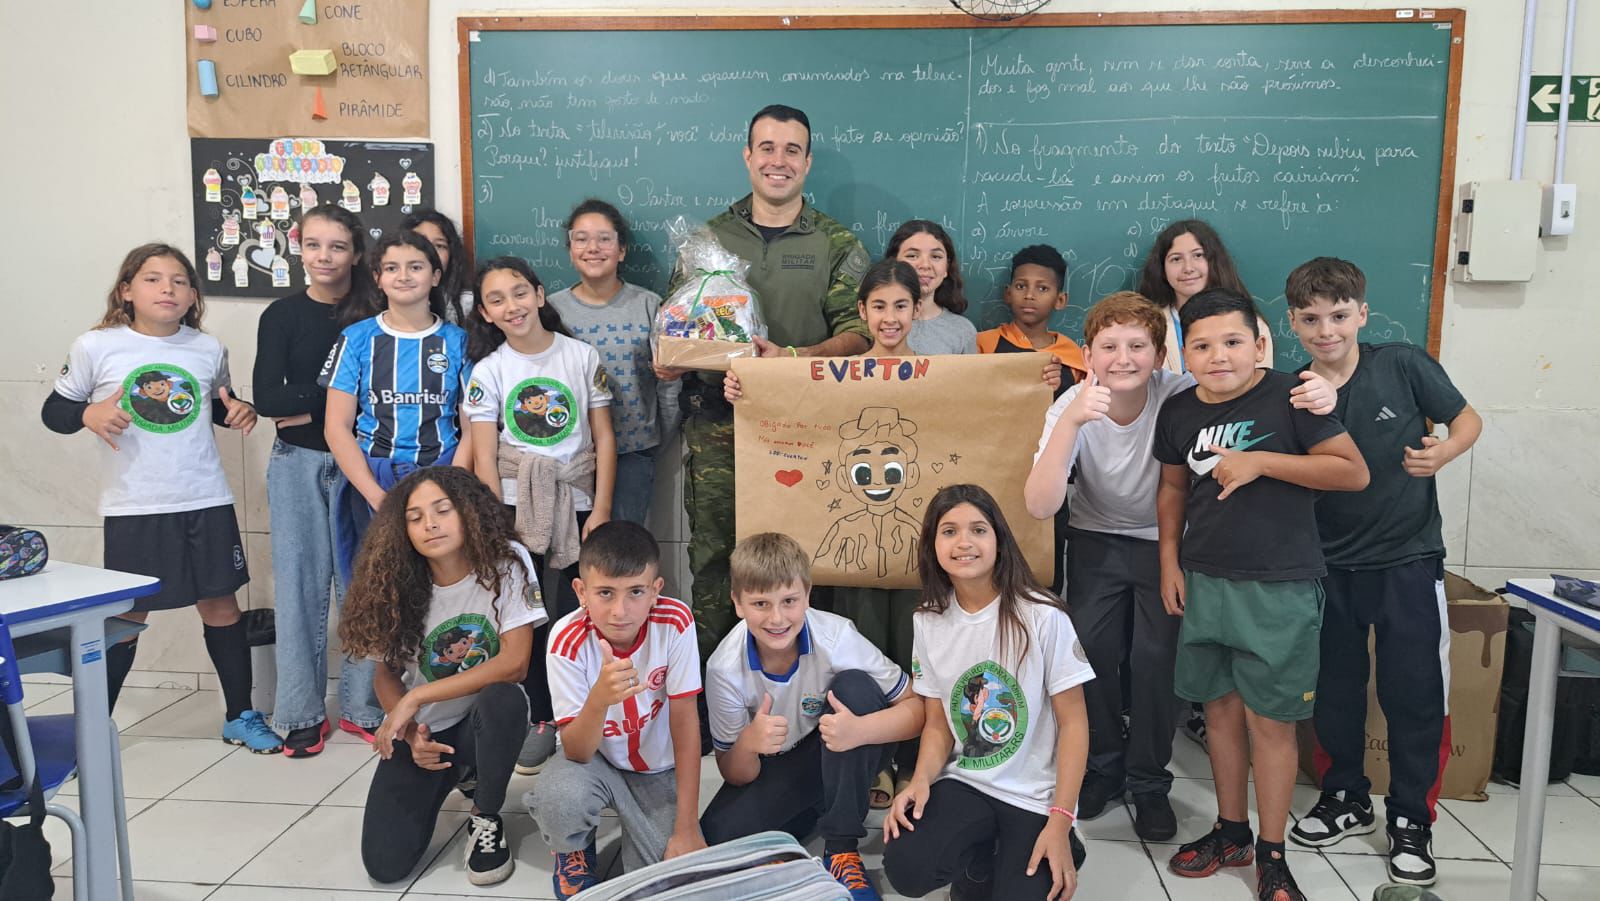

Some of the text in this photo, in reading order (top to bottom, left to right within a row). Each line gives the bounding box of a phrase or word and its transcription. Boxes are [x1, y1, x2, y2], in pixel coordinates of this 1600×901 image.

[325, 5, 364, 20] CONE
[226, 28, 262, 43] CUBO
[342, 43, 385, 57] BLOCO
[981, 53, 1034, 76] Muita
[226, 73, 287, 88] CILINDRO
[652, 71, 687, 88] que
[880, 72, 905, 81] na
[1058, 76, 1097, 94] mal
[1140, 82, 1173, 98] que
[339, 100, 402, 118] PIRÂMIDE
[1196, 133, 1237, 154] texto
[1376, 146, 1419, 167] para
[995, 221, 1049, 238] árvore
[810, 358, 930, 383] EVERTON
[381, 388, 449, 405] Banrisul
[1194, 420, 1256, 453] NIKE
